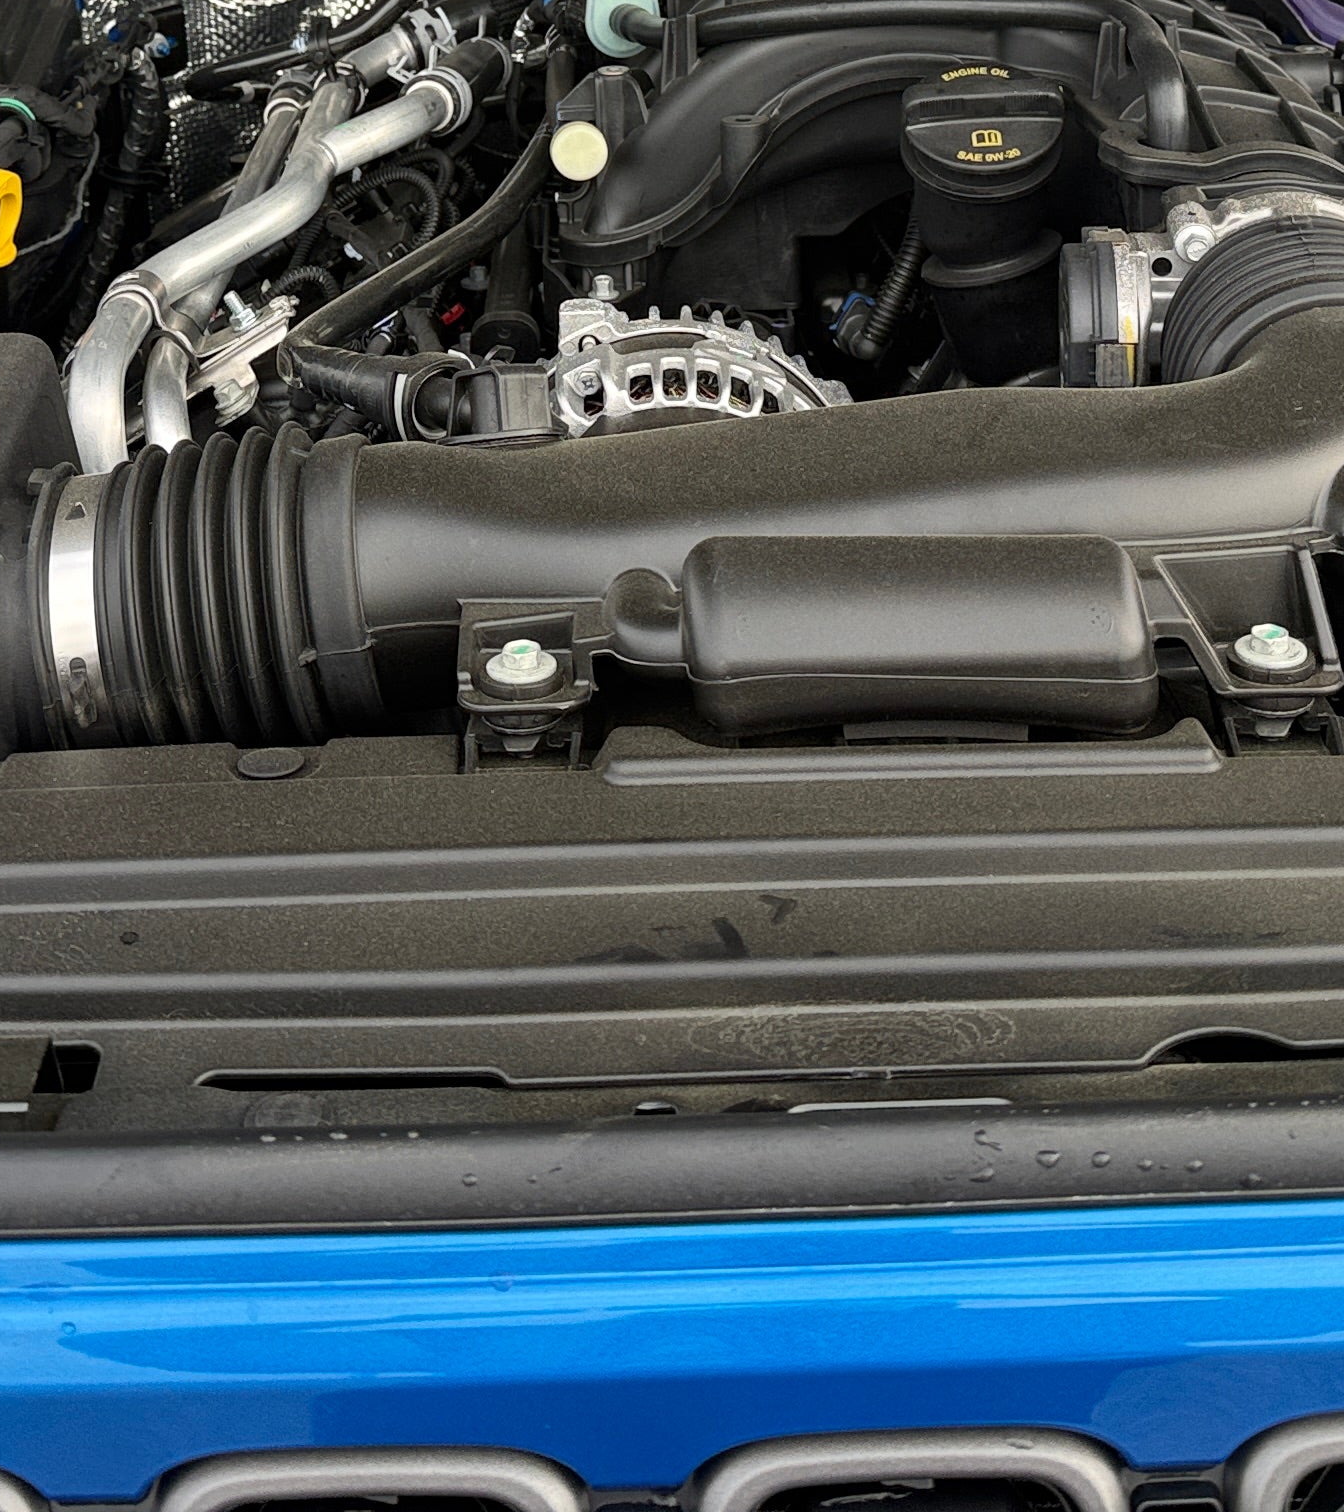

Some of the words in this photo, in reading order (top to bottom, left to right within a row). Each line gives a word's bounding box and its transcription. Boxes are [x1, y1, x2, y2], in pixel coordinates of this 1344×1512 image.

[941, 66, 987, 82] ENGINE
[990, 66, 1011, 79] OIL
[956, 149, 983, 163] SAE
[985, 147, 1022, 163] 0W-20
